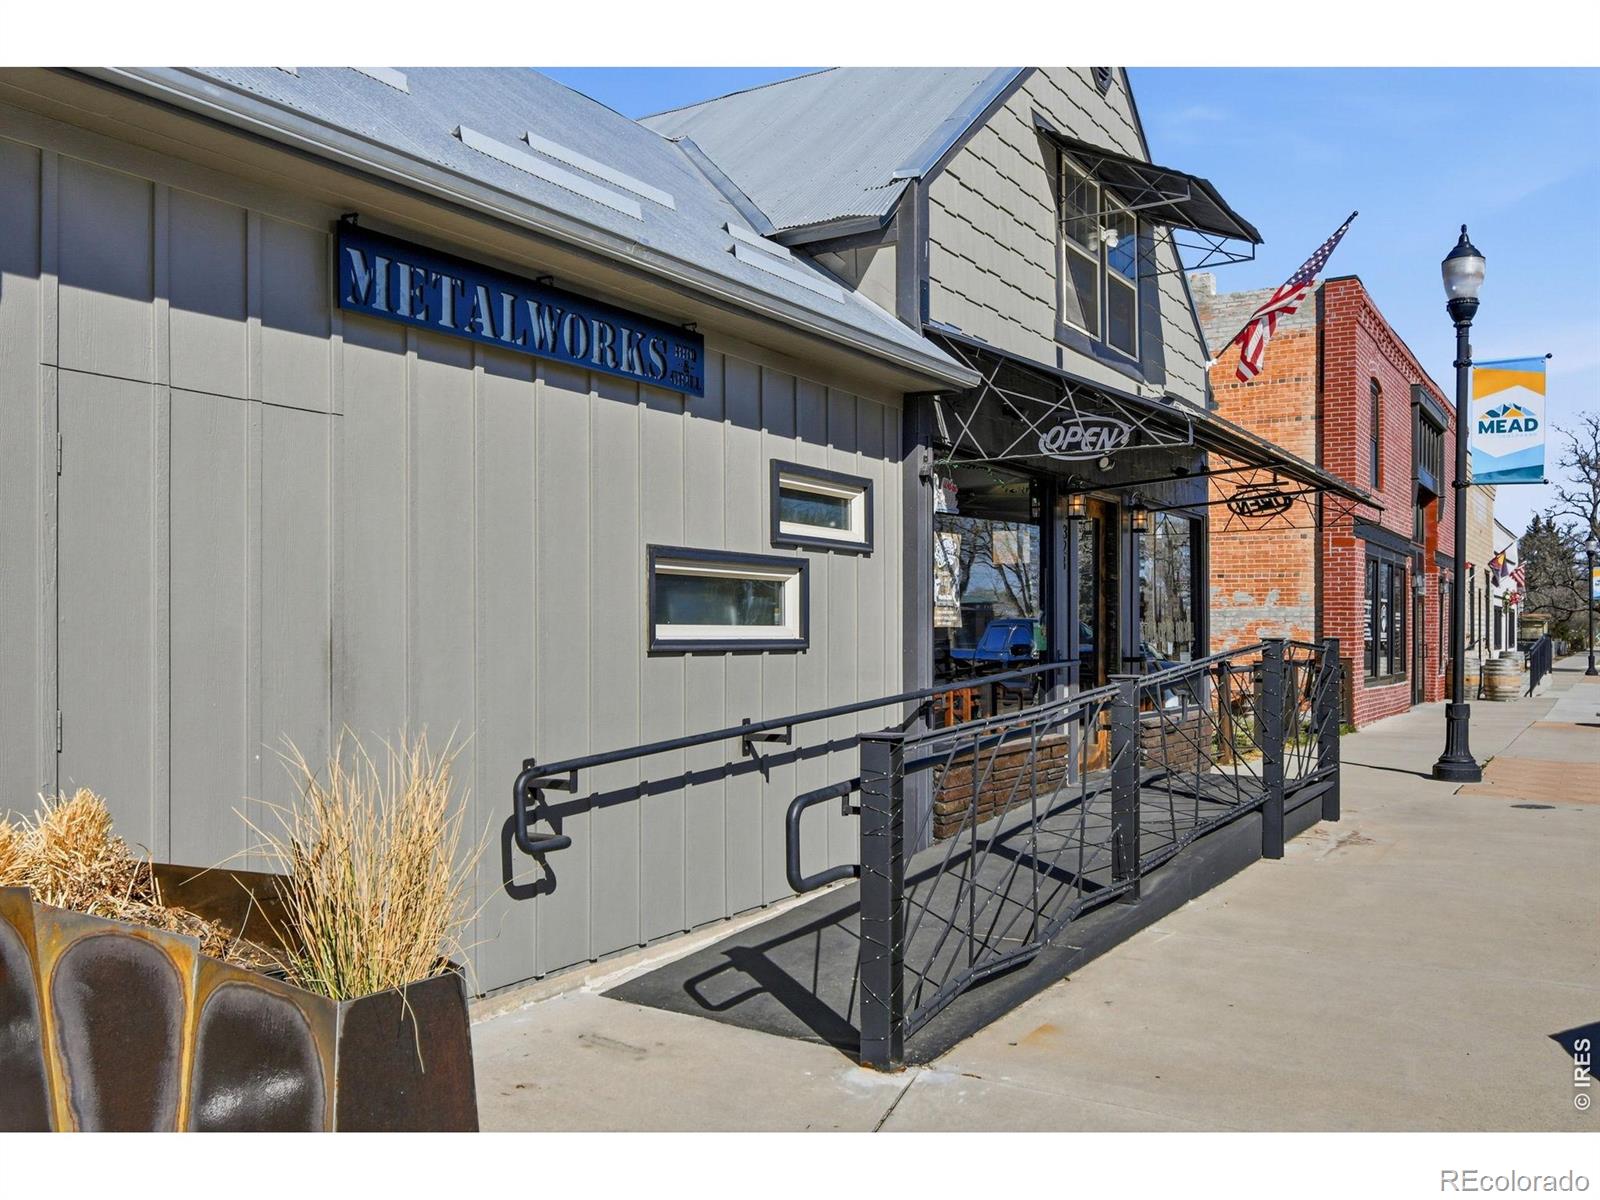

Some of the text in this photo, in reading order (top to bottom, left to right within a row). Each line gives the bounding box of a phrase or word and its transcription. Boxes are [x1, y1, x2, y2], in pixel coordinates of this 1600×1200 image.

[346, 247, 667, 380] METALWORKS
[1046, 425, 1119, 452] OPEN
[1478, 418, 1539, 434] MEAD
